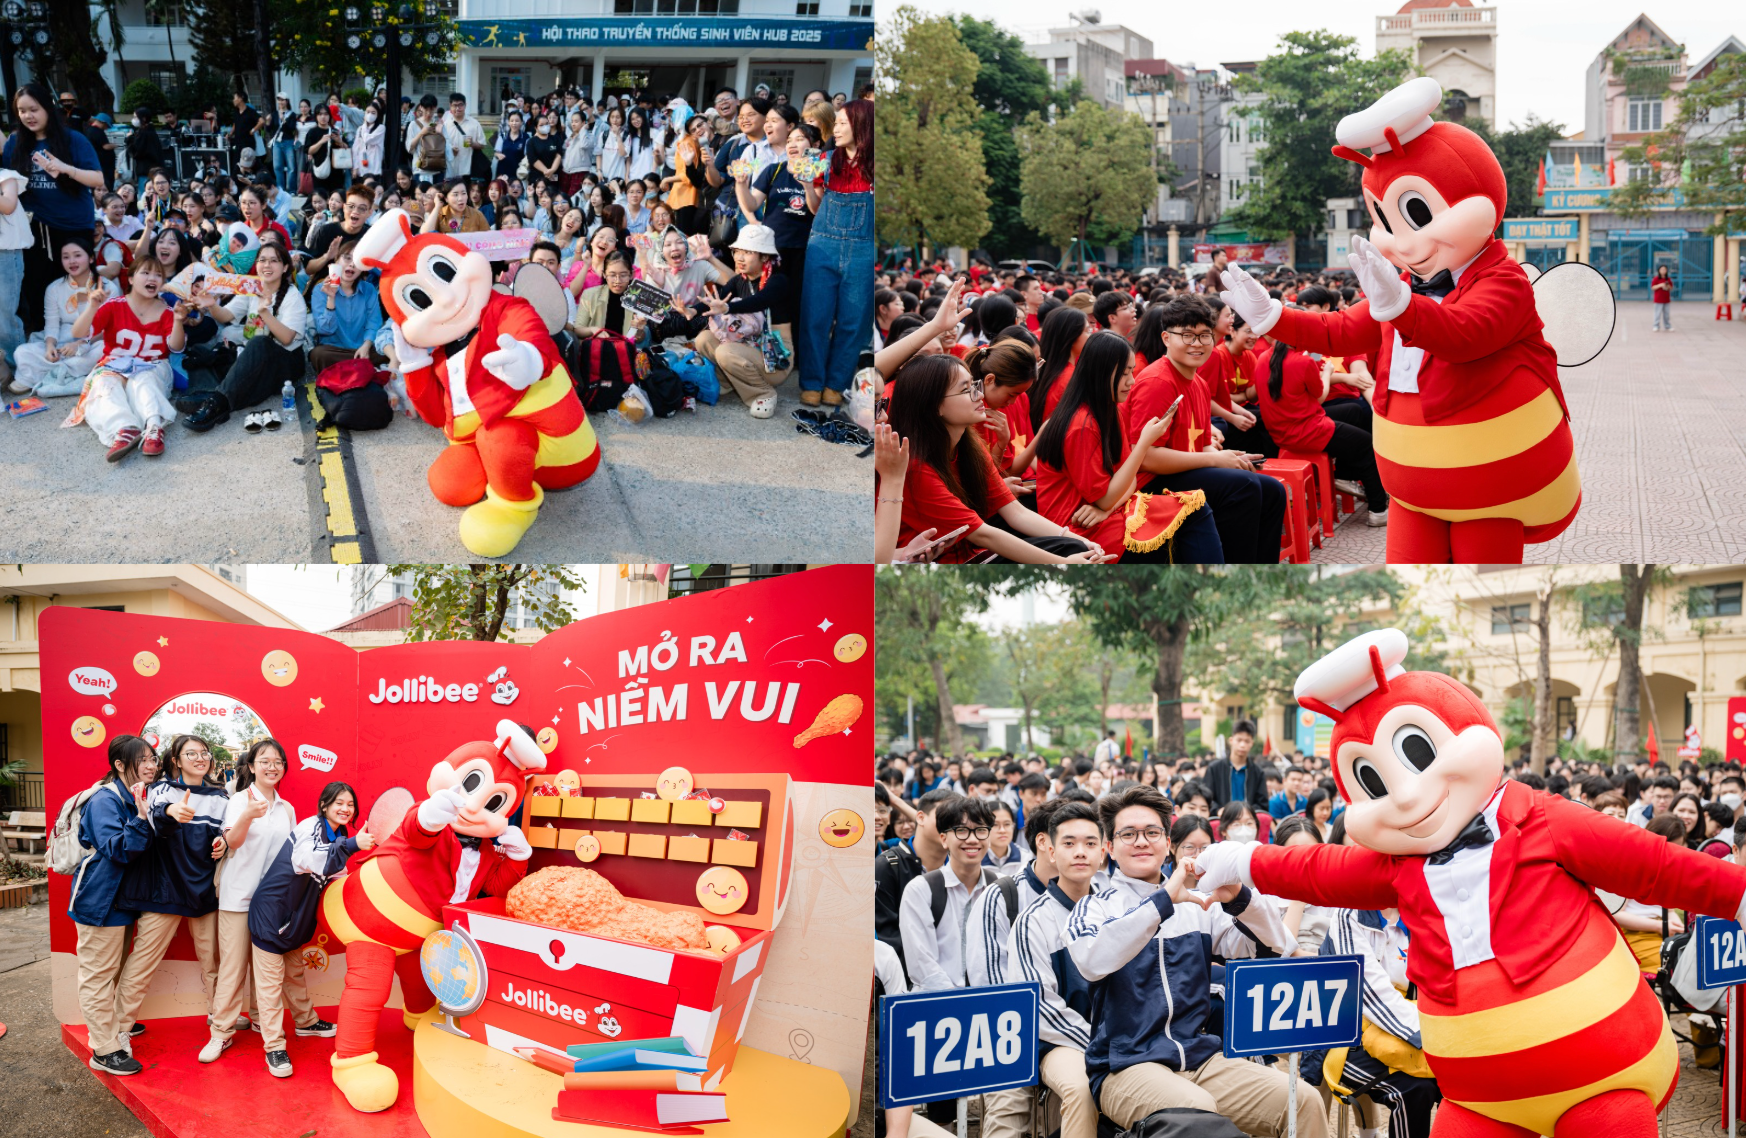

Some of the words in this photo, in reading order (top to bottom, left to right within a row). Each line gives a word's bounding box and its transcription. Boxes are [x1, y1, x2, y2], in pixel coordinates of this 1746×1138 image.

[542, 25, 563, 42] HỘI
[566, 28, 599, 39] THAO
[655, 22, 698, 39] THỐNG
[700, 28, 730, 40] SINH
[733, 25, 760, 40] VIÊN
[763, 29, 788, 41] HUB
[790, 30, 822, 42] 2025
[109, 328, 164, 357] 25
[618, 630, 679, 679] MỞ
[689, 631, 748, 667] RA
[75, 673, 111, 689] Yeah!
[368, 675, 479, 704] Jollibee
[167, 702, 227, 717] Jollibee
[577, 676, 689, 735] NIỀM
[704, 680, 801, 725] VUI
[302, 750, 333, 766] Smile!!
[501, 982, 587, 1025] Jollibee
[1246, 979, 1348, 1033] 12A7
[906, 1010, 1022, 1077] 12A8
